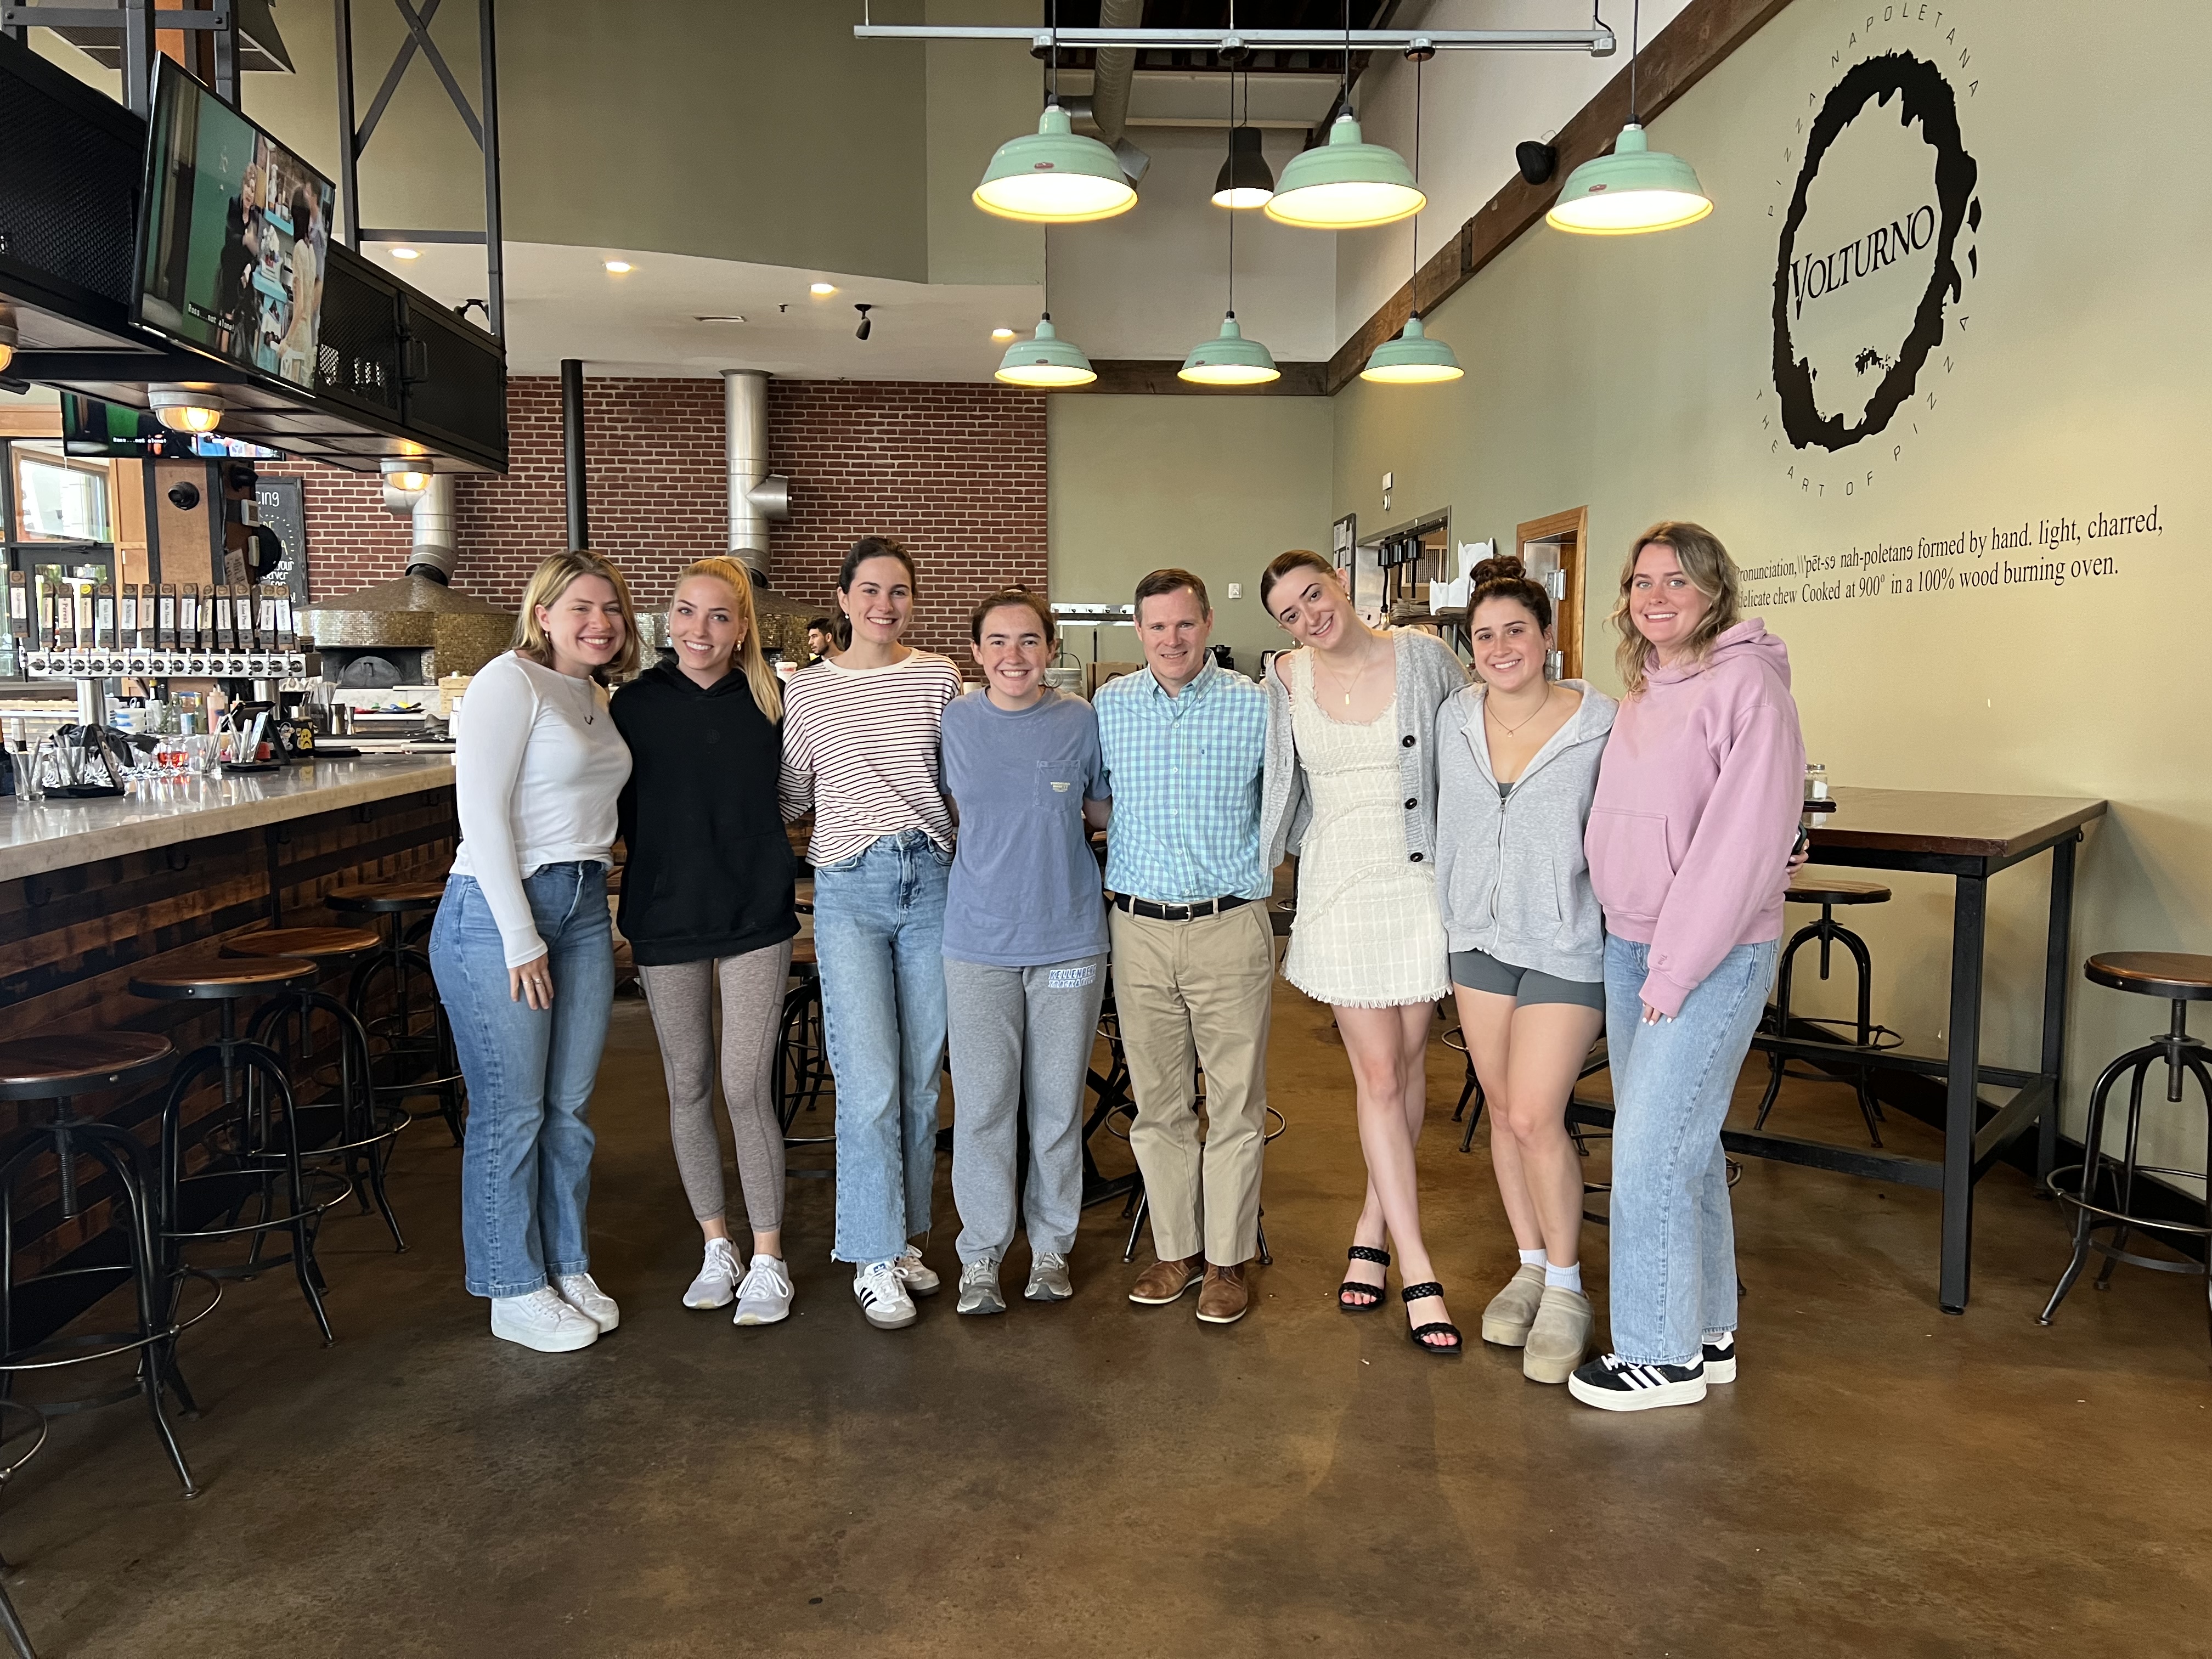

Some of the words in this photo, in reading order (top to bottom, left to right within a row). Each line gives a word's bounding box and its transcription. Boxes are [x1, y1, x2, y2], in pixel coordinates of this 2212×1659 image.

[1831, 2, 1979, 97] NAPOLETANA
[1790, 205, 1935, 320] VOLTURNO
[1756, 389, 1779, 454] THE
[1787, 466, 1825, 497] ART
[1846, 471, 1873, 496] OF
[1917, 531, 1965, 559] formed
[1970, 530, 1987, 558] by
[1991, 522, 2032, 550] hand.
[2039, 517, 2081, 550] light,
[2087, 504, 2163, 539] charred,
[1773, 586, 1797, 605] chew
[1802, 579, 1841, 602] Cooked
[1846, 580, 1855, 599] at
[1891, 573, 1902, 594] in
[1906, 578, 1913, 593] a
[1918, 567, 1955, 592] 100%
[1960, 561, 1999, 588] wood
[2004, 556, 2066, 586] burning
[2070, 556, 2119, 578] oven.
